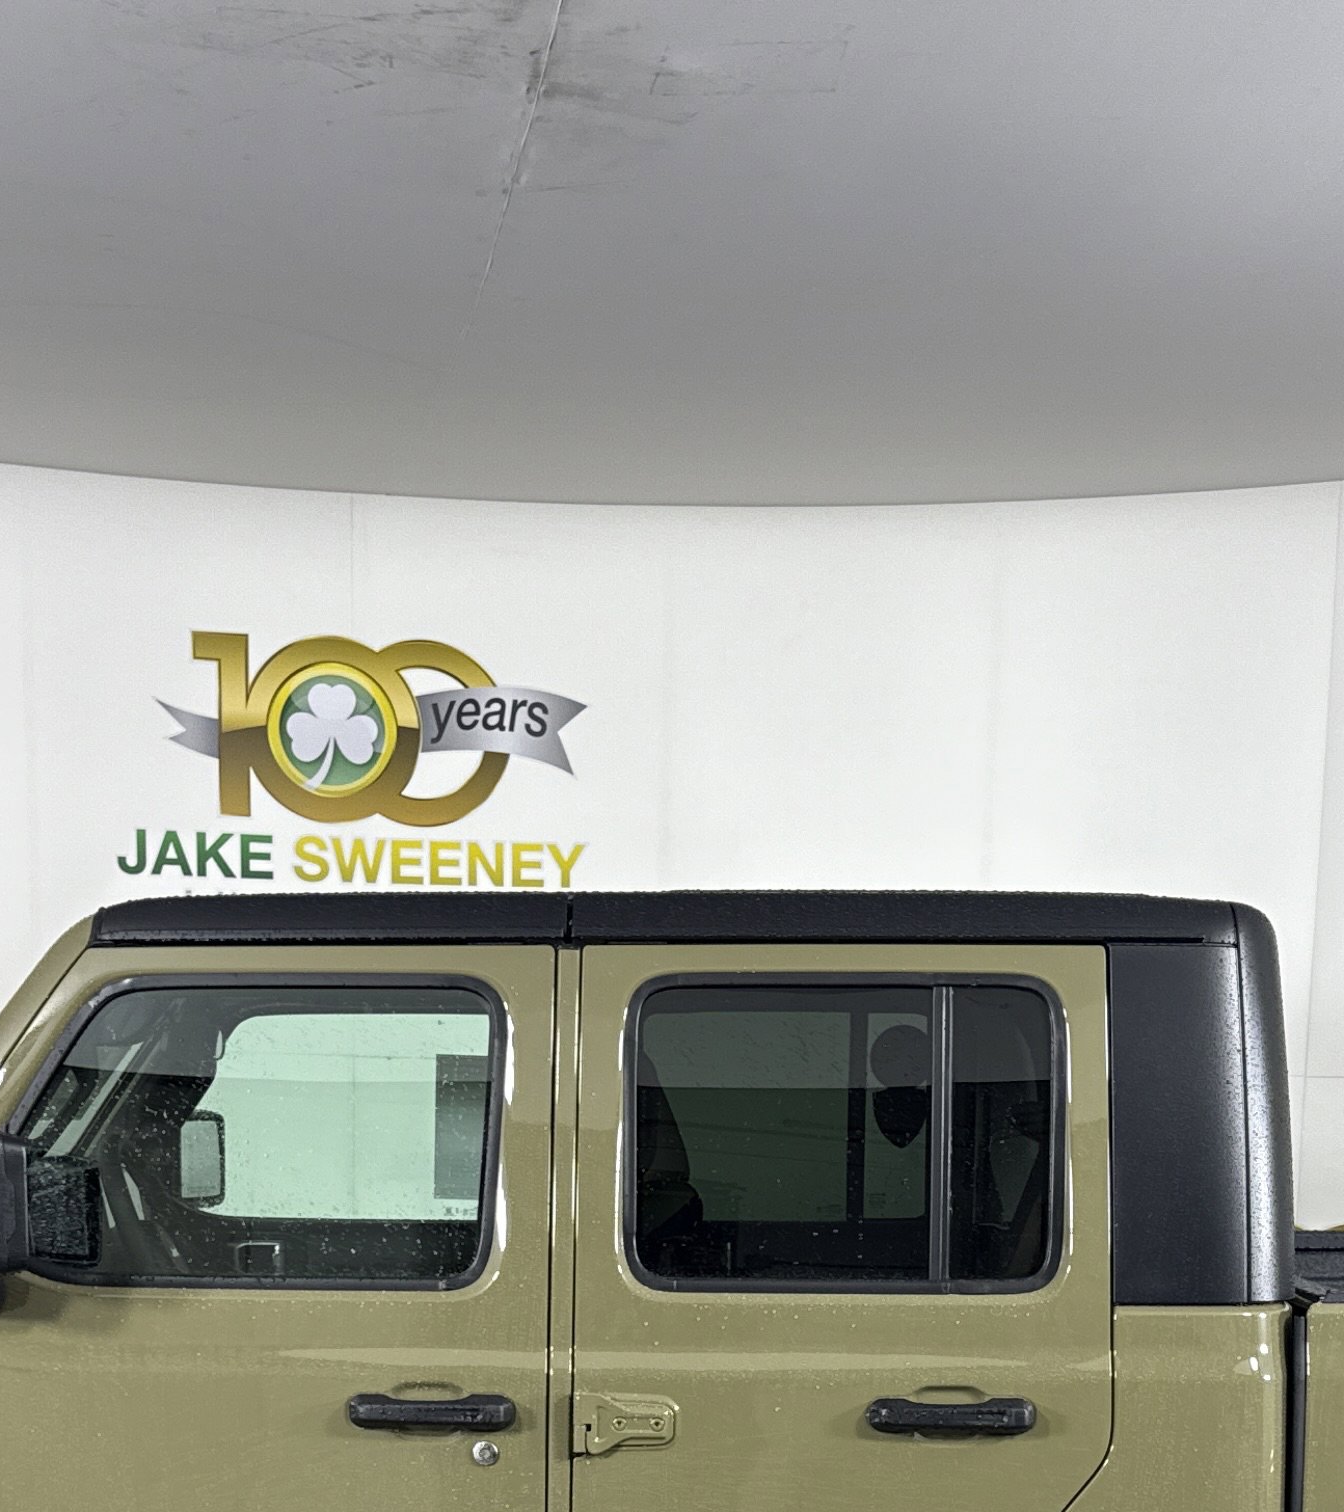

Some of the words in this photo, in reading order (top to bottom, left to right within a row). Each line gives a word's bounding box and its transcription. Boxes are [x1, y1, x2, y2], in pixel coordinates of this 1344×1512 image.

[191, 630, 511, 828] 100
[430, 695, 550, 744] years
[117, 829, 274, 879] JAKE
[293, 836, 586, 889] SWEENEY
